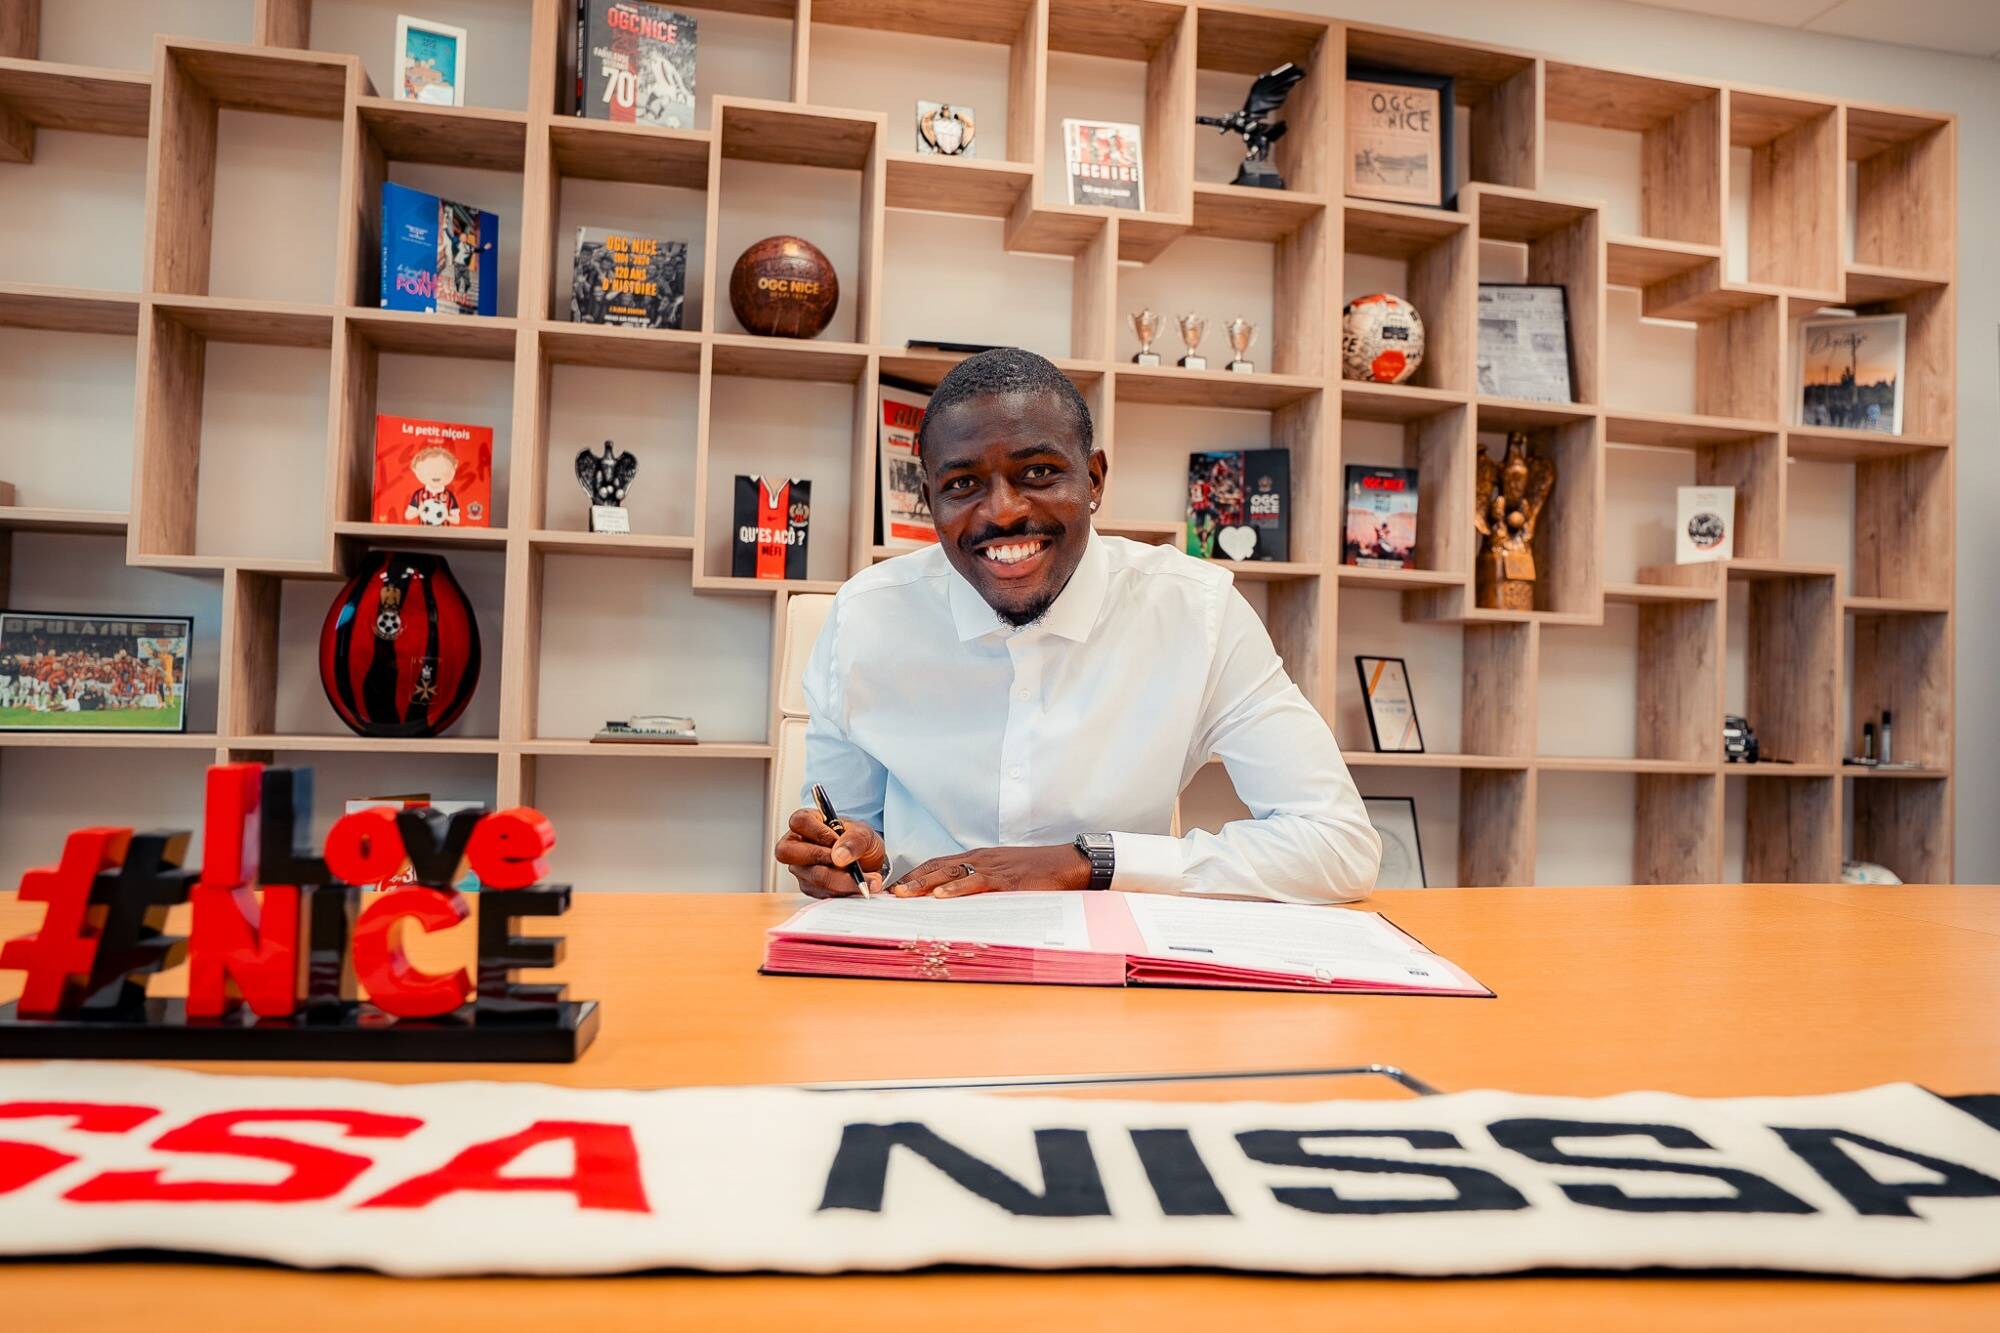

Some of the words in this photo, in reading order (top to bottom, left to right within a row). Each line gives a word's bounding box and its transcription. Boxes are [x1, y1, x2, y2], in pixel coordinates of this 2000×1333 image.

[1371, 92, 1413, 114] OGC
[1387, 110, 1431, 133] NICE
[607, 236, 628, 252] OGC
[632, 238, 657, 255] NICE
[758, 277, 788, 292] OGC
[790, 280, 820, 295] NICE
[402, 422, 414, 434] Le
[415, 425, 440, 437] petit
[441, 427, 470, 441] niçois
[740, 526, 772, 543] QU'ES
[185, 883, 573, 1018] NICE
[815, 1117, 2000, 1221] NISSA
